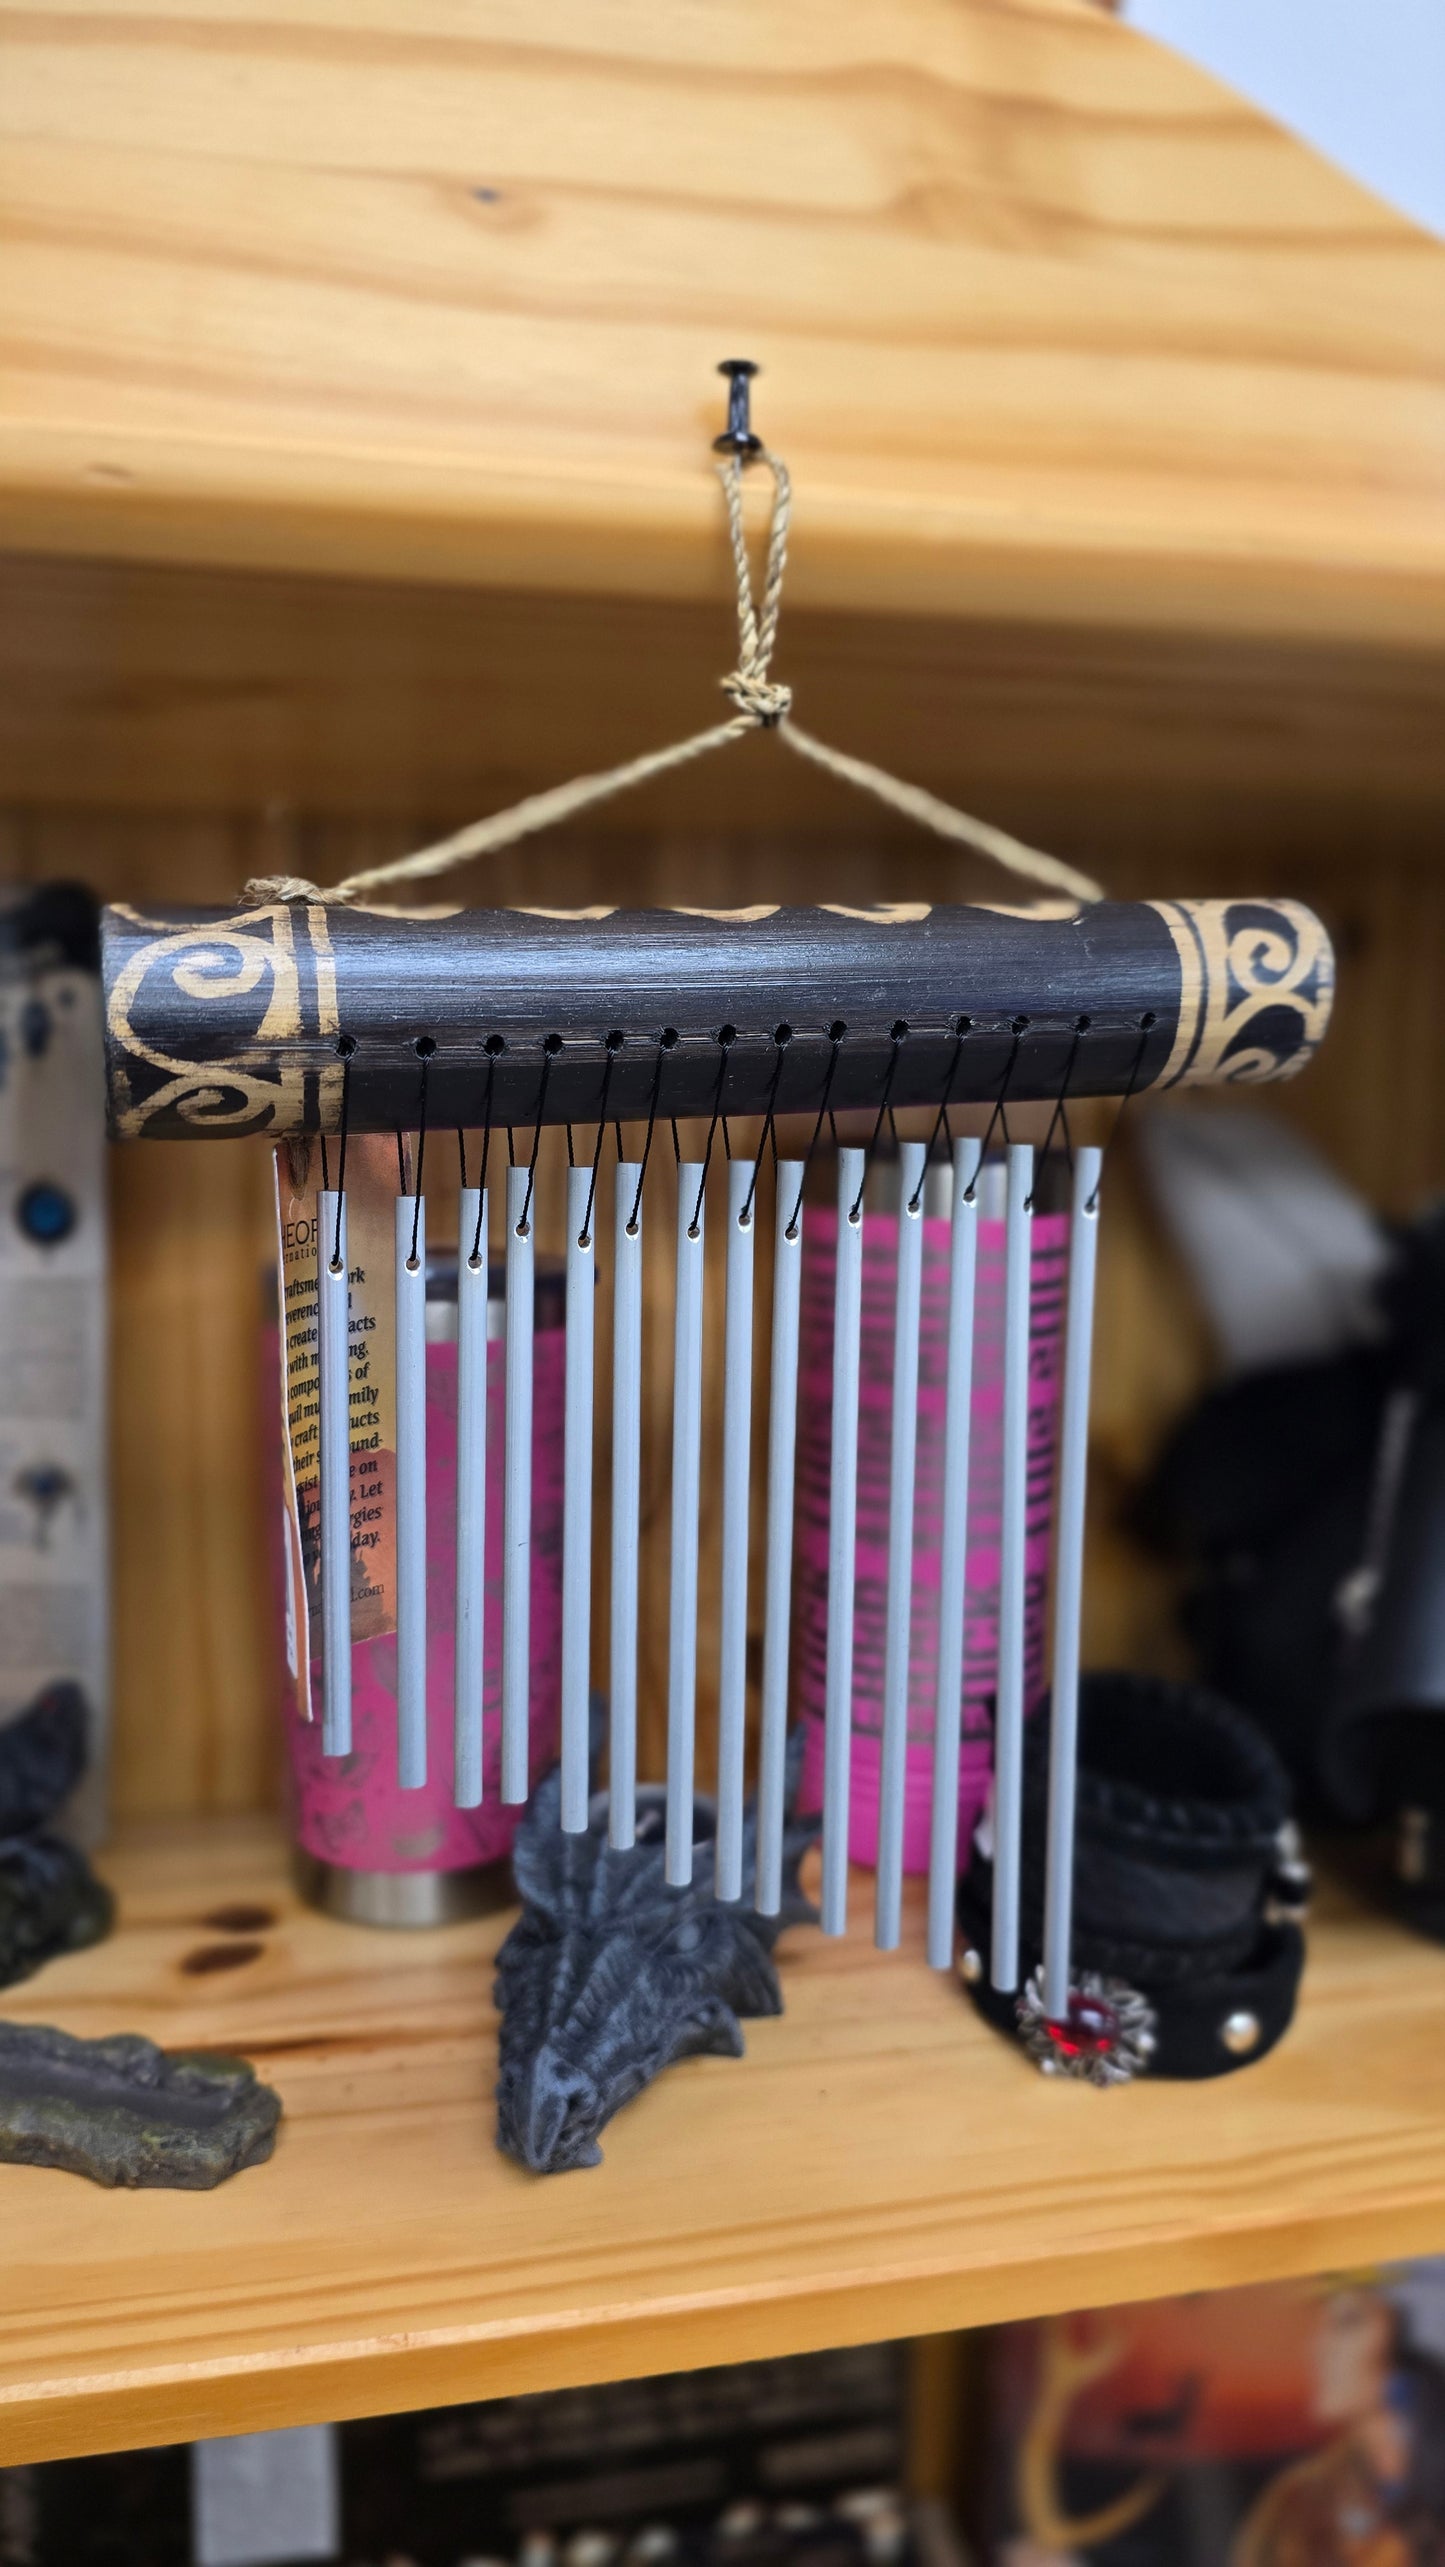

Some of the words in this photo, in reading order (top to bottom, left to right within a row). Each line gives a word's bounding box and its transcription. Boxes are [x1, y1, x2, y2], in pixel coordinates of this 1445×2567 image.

[289, 1327, 318, 1350] create
[289, 1352, 309, 1375] with
[355, 1361, 371, 1379] of
[360, 1459, 377, 1475] on
[360, 1480, 383, 1499] Let
